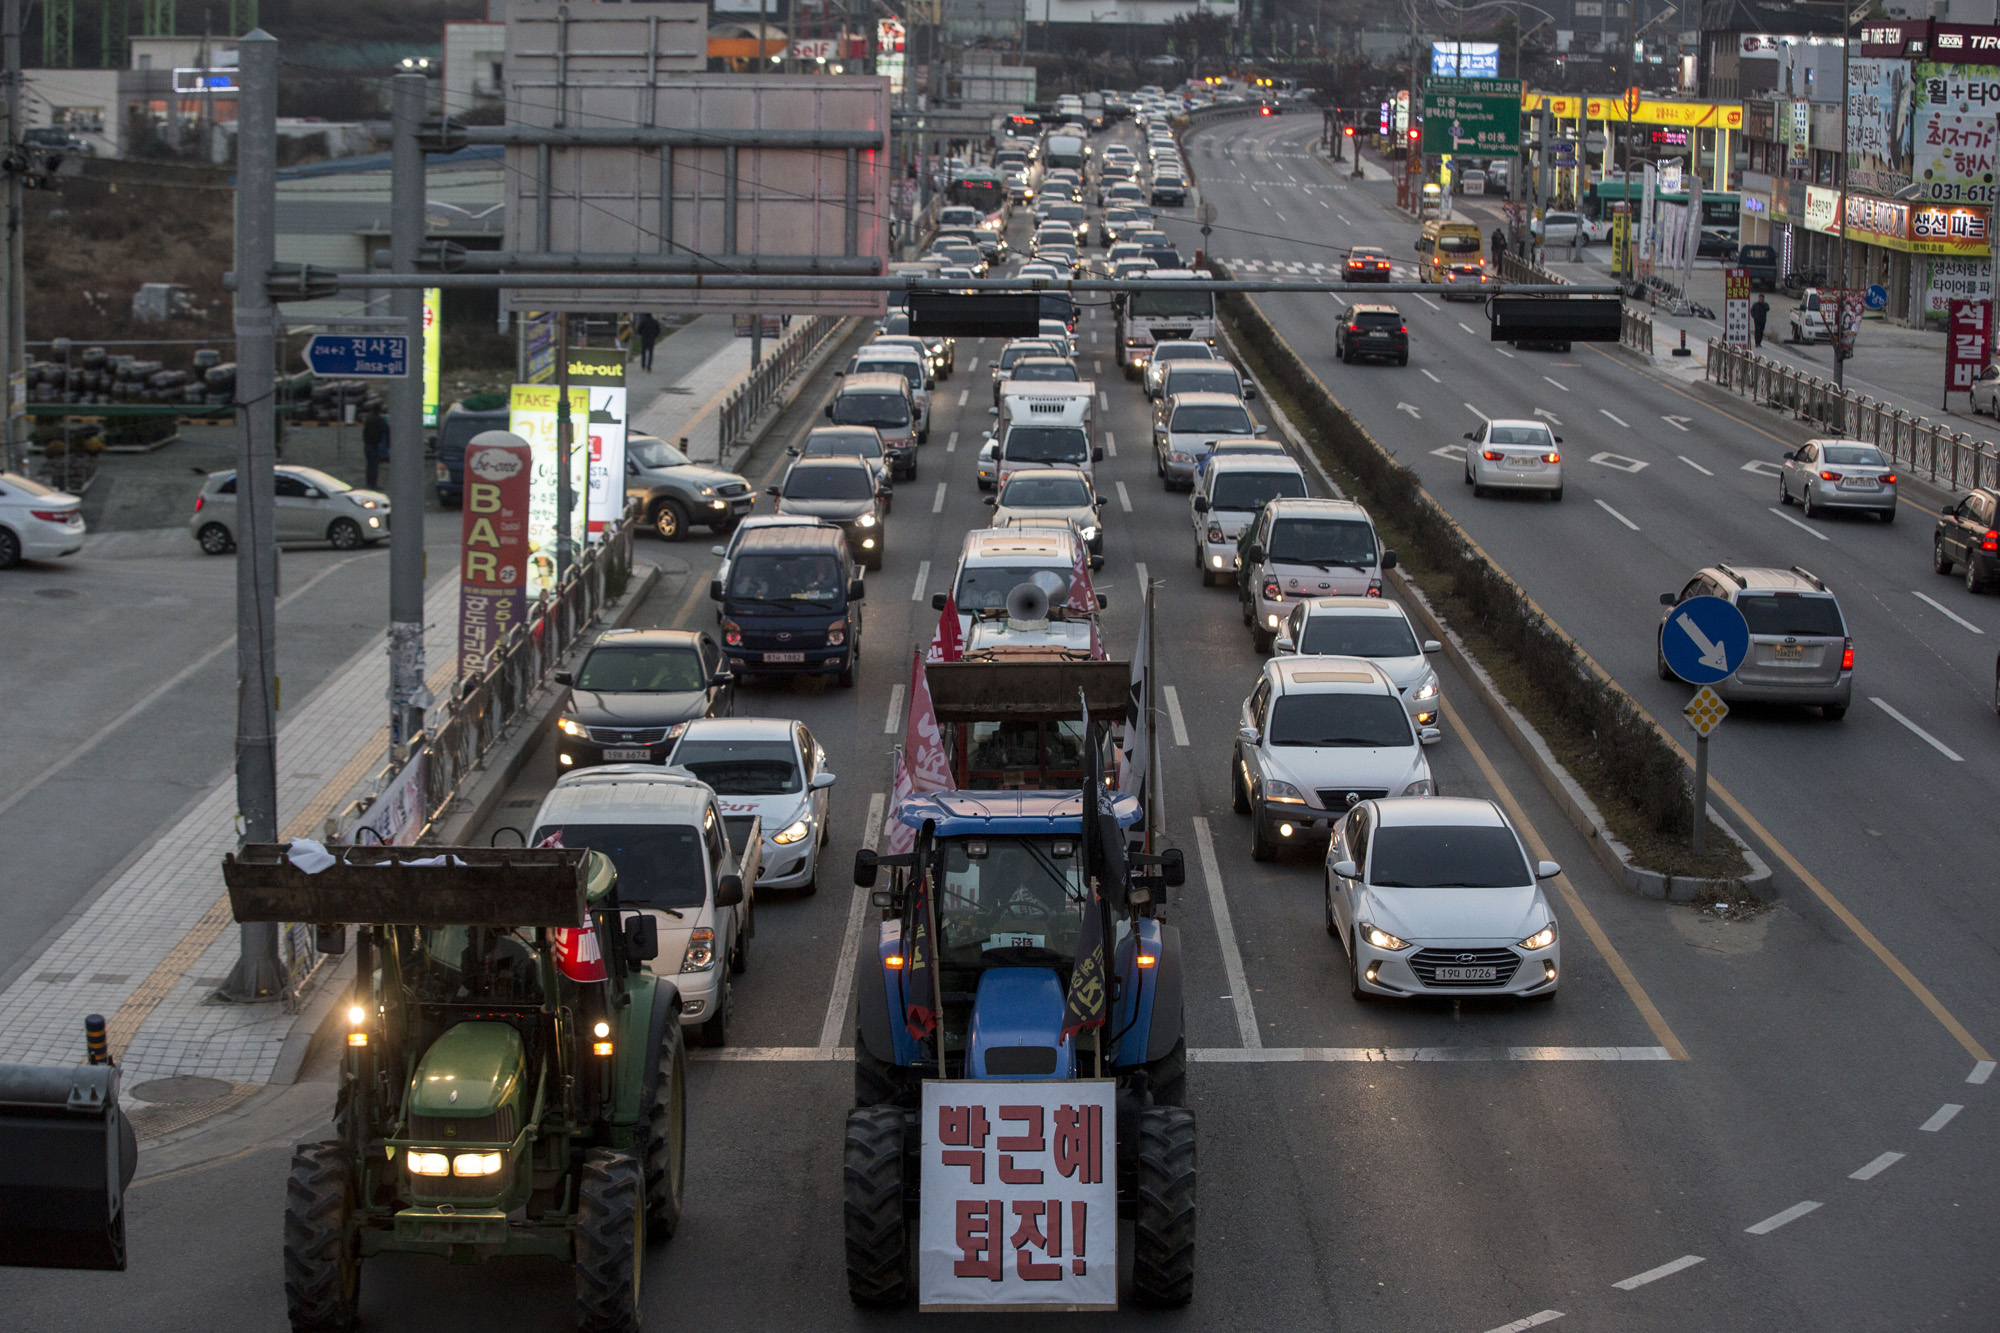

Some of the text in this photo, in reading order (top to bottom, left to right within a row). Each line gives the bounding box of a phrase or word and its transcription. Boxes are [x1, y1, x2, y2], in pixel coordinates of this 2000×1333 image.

[1870, 28, 1884, 44] TIRE
[1885, 28, 1901, 44] TECH
[1457, 101, 1483, 110] Anjung
[1926, 120, 1991, 148] 최저가
[1477, 142, 1518, 152] Yongi-dong
[1914, 212, 1985, 238] 생선 파는
[1933, 261, 1978, 277] 생선처럼
[1933, 280, 1977, 298] 타이어를
[352, 339, 403, 358] 진사길
[1953, 304, 1985, 386] 석갈비
[354, 360, 403, 374] Jinsa-gil
[567, 361, 623, 376] ake-out
[515, 393, 586, 408] TAKE-UT
[467, 482, 502, 582] BAR
[501, 569, 514, 579] 2F
[625, 751, 647, 759] 6674
[1465, 968, 1491, 978] 0726
[938, 1104, 1103, 1184] 박근혜
[954, 1199, 1087, 1281] 퇴진!
